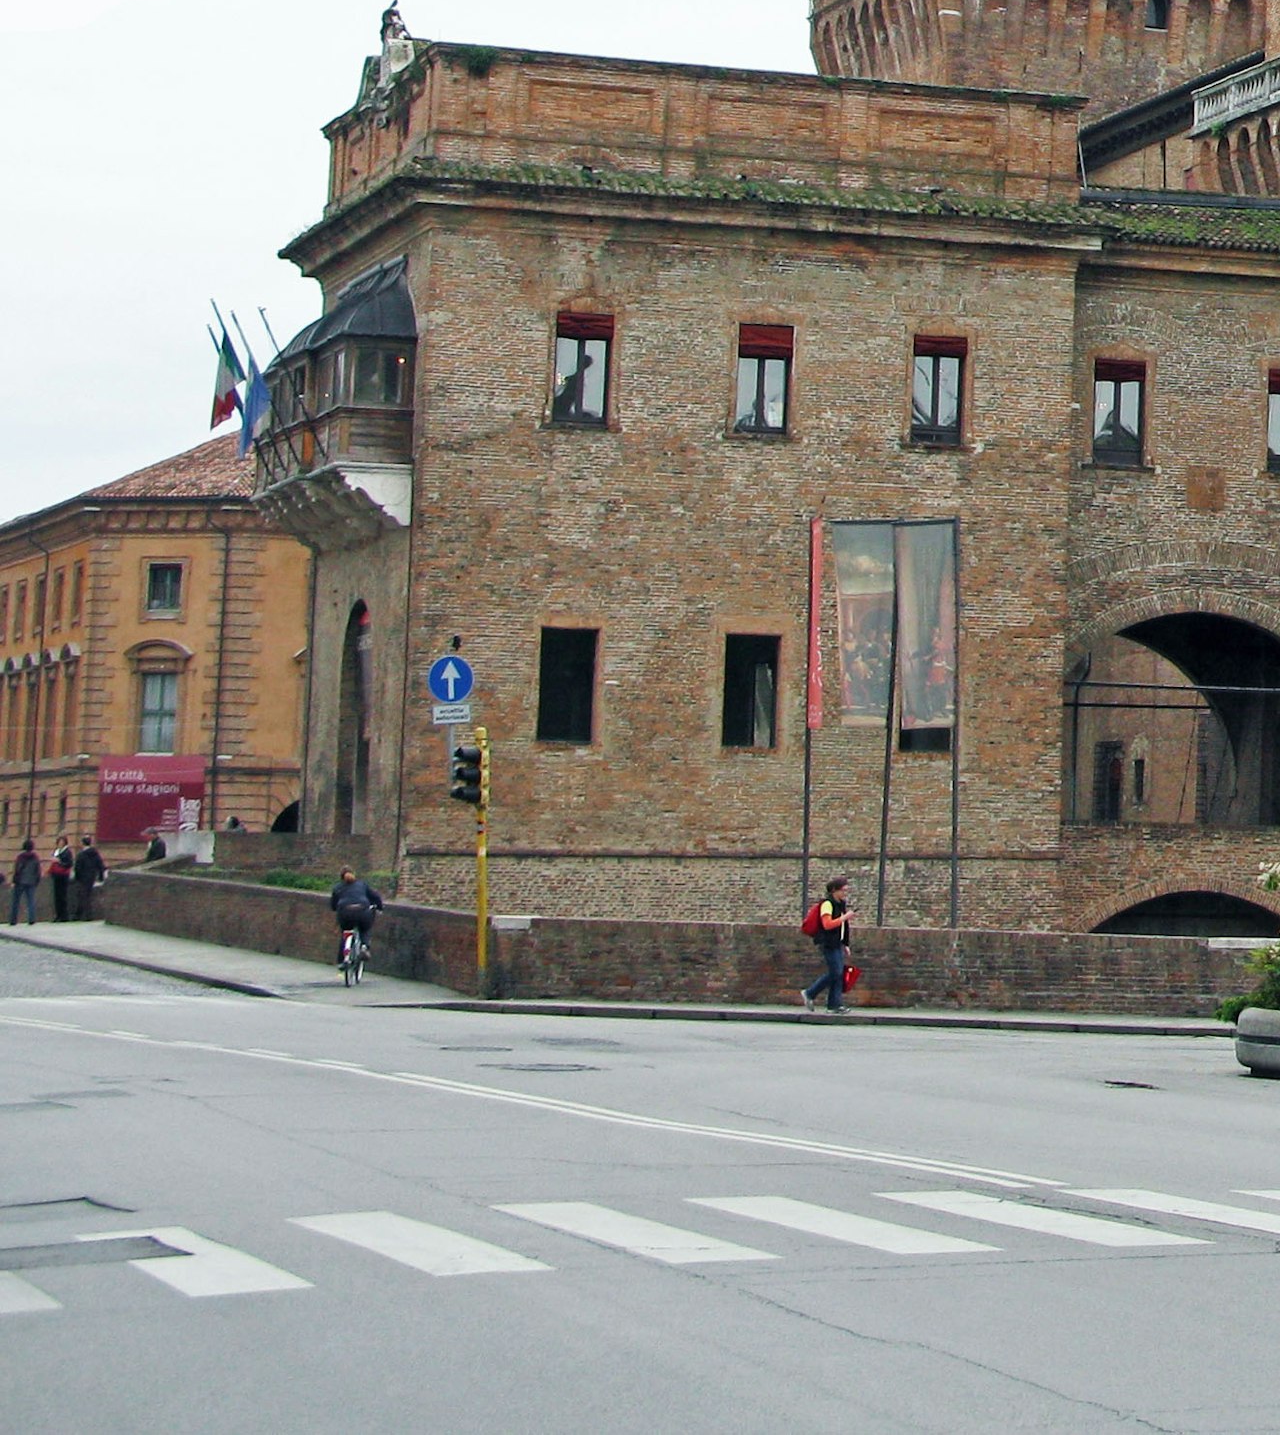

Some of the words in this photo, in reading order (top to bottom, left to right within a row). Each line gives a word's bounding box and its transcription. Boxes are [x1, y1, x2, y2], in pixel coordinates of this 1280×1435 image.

[104, 769, 117, 781] La
[103, 782, 113, 794] le
[115, 785, 134, 793] sue
[136, 782, 180, 796] stagioni
